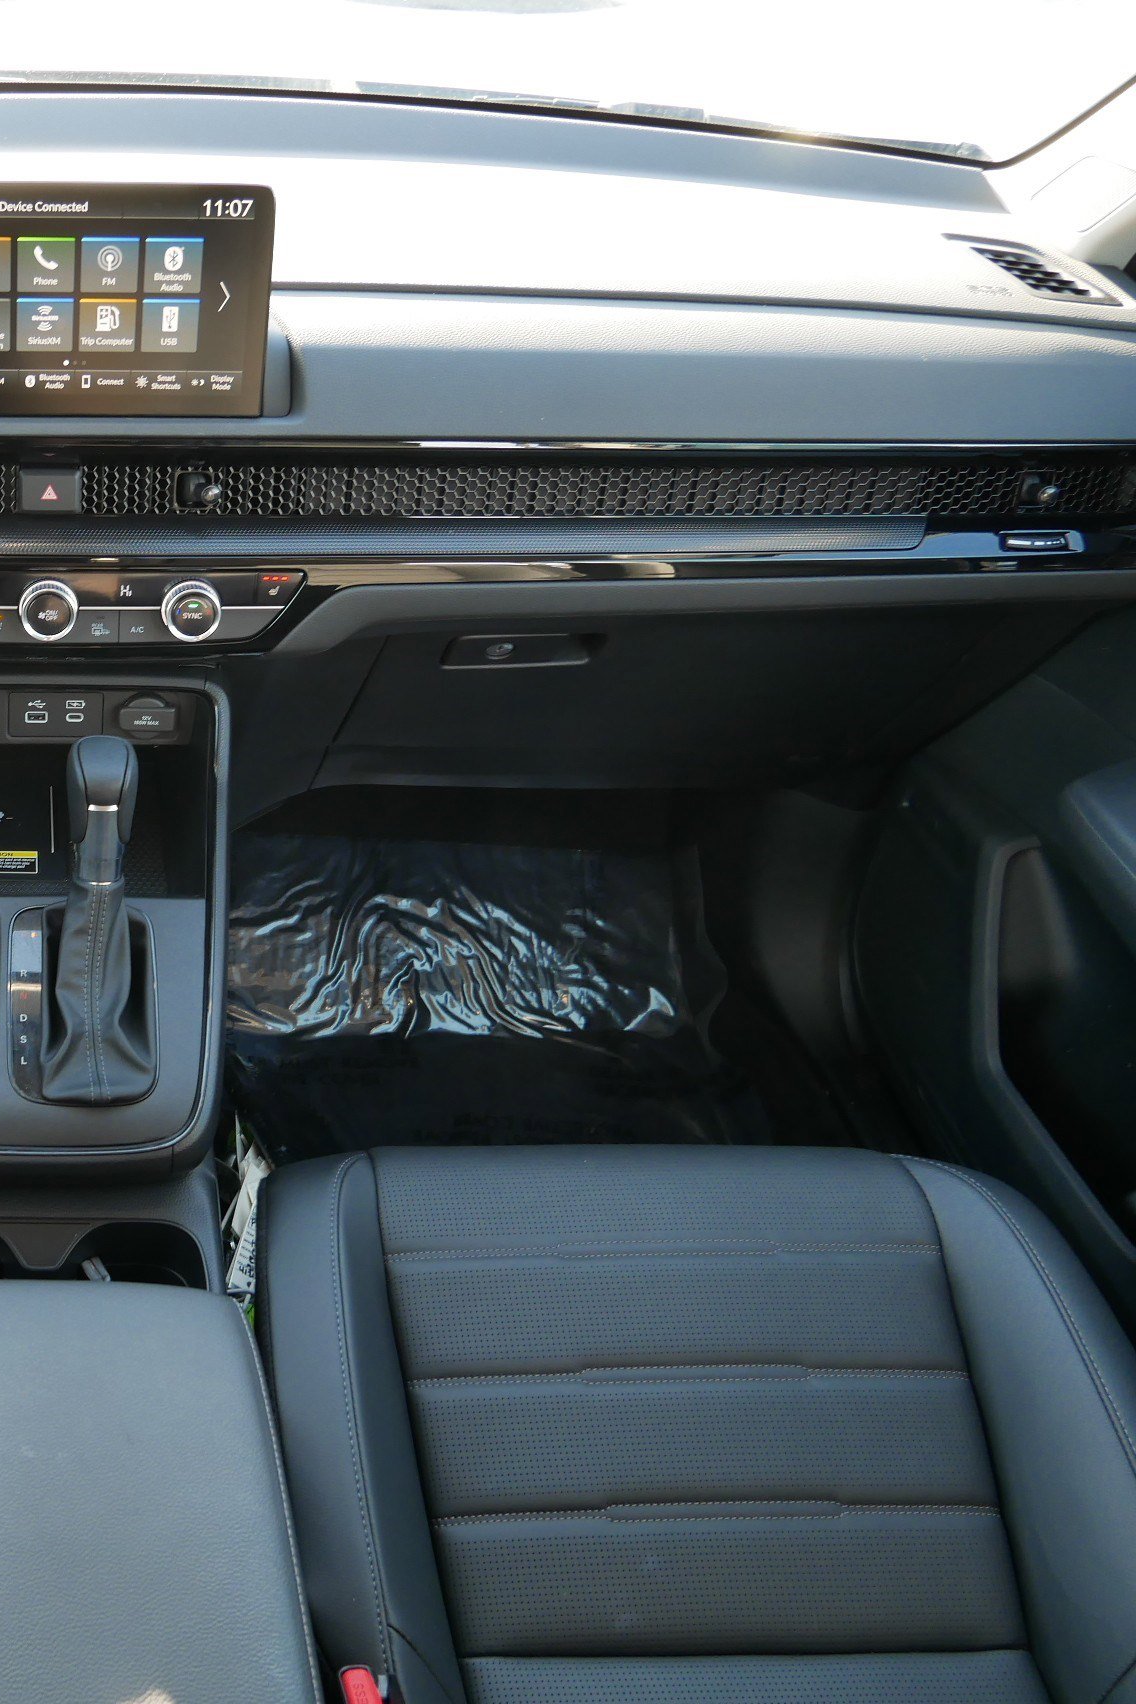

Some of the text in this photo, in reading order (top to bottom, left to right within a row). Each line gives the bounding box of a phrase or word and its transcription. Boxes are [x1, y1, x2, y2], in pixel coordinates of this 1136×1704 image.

[38, 201, 89, 213] Connected
[202, 199, 254, 217] 11:07
[33, 277, 58, 286] Phone
[101, 277, 116, 286] FM
[153, 272, 192, 282] Bluetooth
[159, 282, 183, 292] Audio
[27, 336, 62, 345] SiriusXM
[80, 337, 134, 347] Trip Computer
[160, 337, 178, 346] USB
[39, 373, 70, 382] Bluetooth
[96, 378, 124, 386] Connect
[156, 374, 176, 382] Smart
[210, 375, 235, 384] Display
[45, 382, 65, 390] Audio
[150, 382, 181, 390] Shortcuts
[211, 382, 231, 391] Mode
[129, 626, 144, 634] A/C
[19, 1013, 28, 1022] D
[20, 1035, 28, 1044] S
[20, 1056, 28, 1065] L
